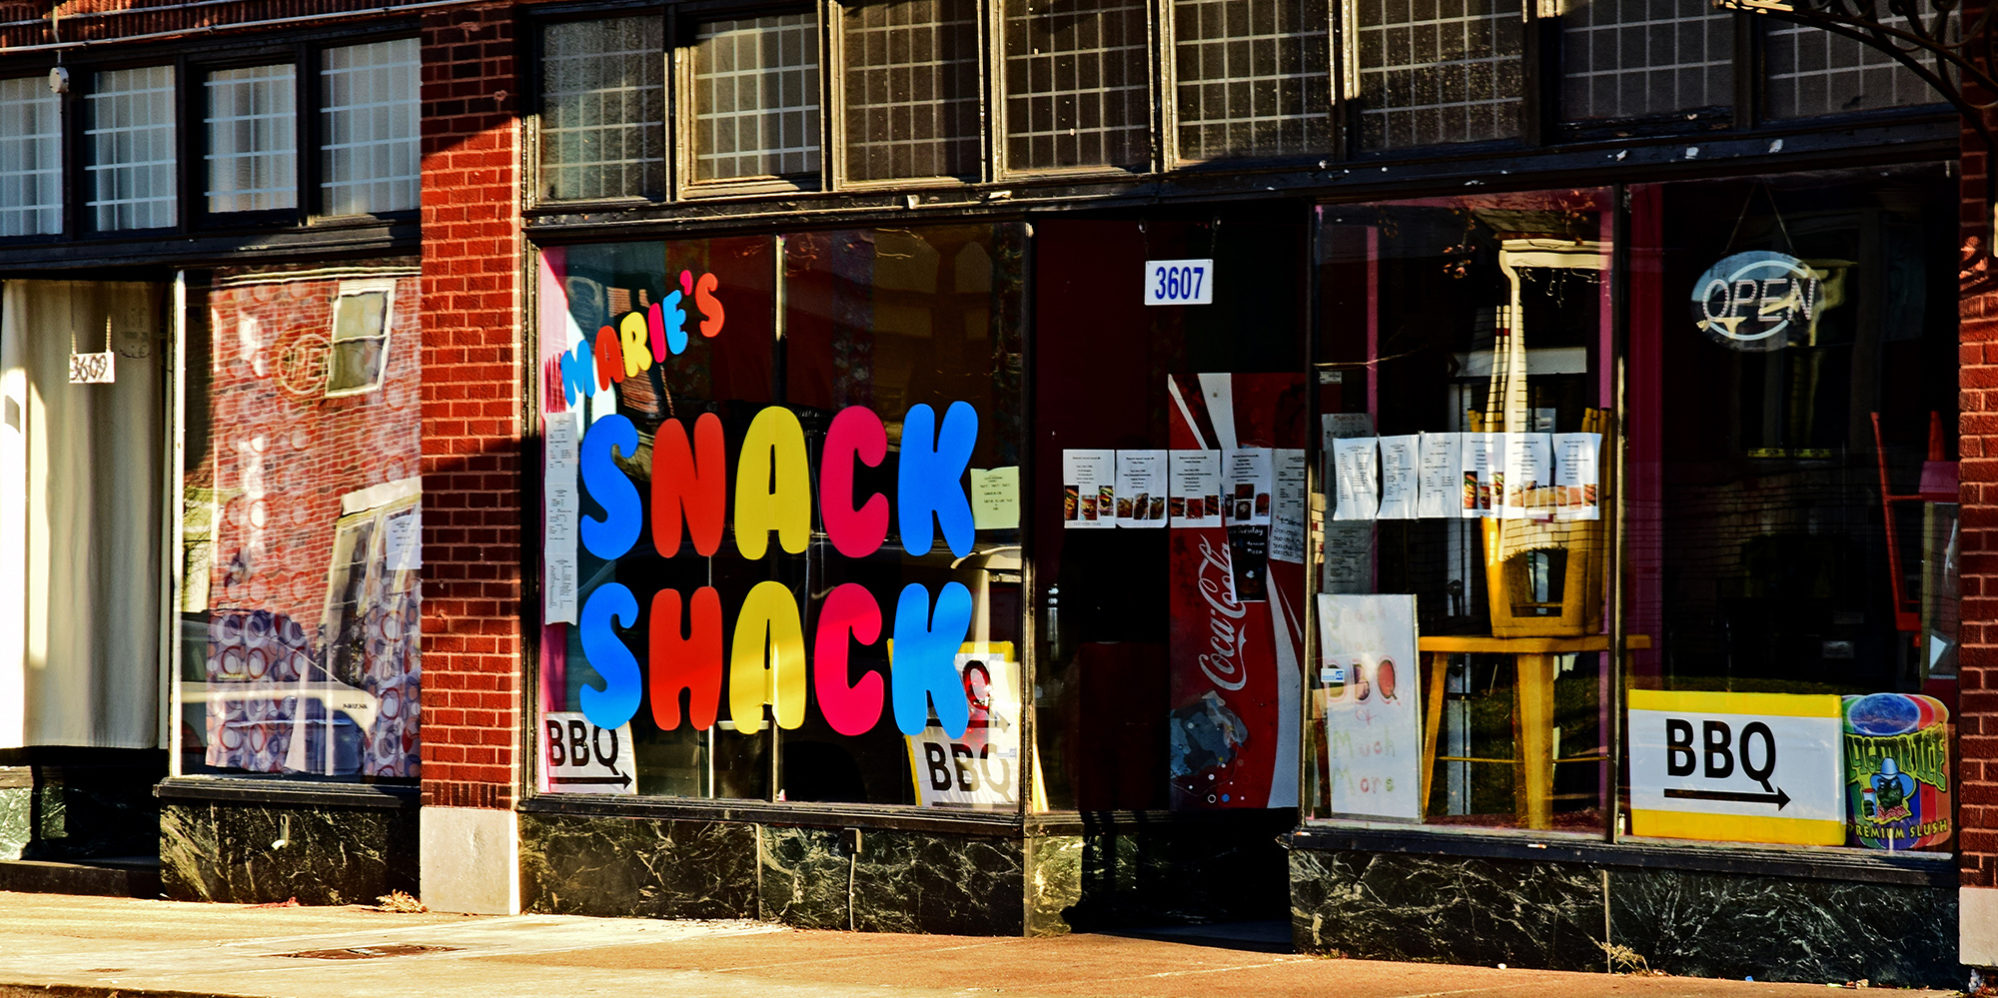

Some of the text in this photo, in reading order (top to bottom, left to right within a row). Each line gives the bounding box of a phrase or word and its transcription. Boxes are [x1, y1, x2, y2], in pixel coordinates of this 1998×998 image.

[1155, 266, 1204, 300] 3607
[1702, 278, 1816, 321] OPEN
[69, 354, 107, 382] 3609
[560, 270, 725, 408] MARIE'S
[580, 401, 979, 560] SNACK
[579, 580, 973, 739] SHACK
[546, 720, 619, 776] BBQ
[923, 742, 1015, 803] BBQ
[1666, 718, 1776, 793] BBQ
[1910, 819, 1947, 838] SLUSH
